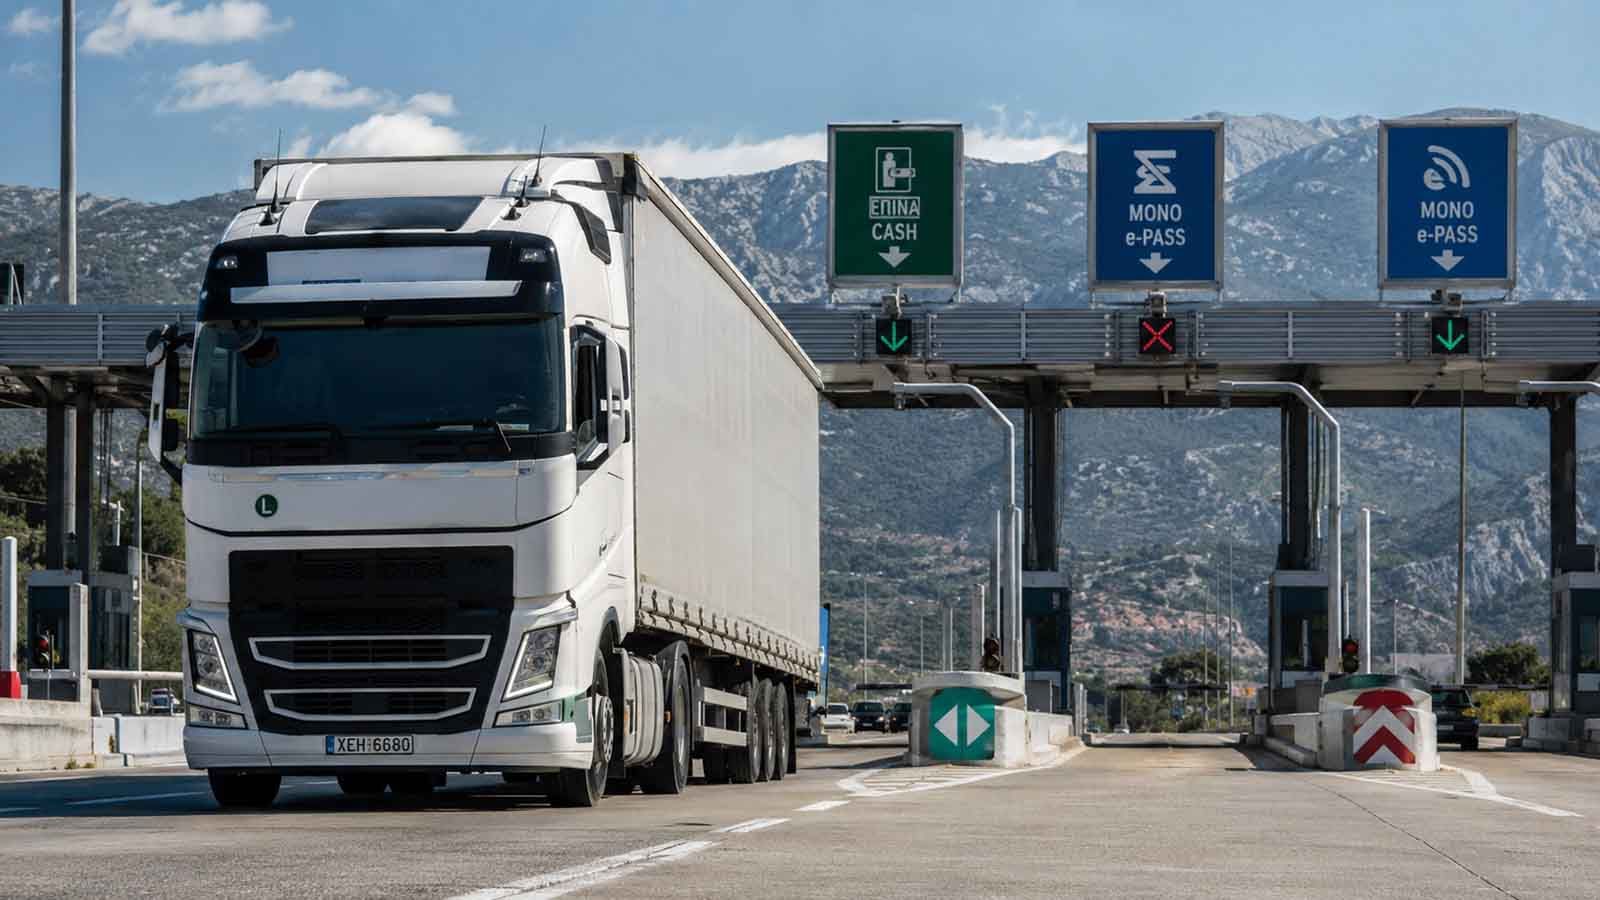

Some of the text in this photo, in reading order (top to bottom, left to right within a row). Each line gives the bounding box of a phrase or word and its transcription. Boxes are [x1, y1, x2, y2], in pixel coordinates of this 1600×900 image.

[872, 223, 917, 240] CASH
[1126, 228, 1186, 246] e-PASS
[1417, 225, 1478, 243] e-PASS
[262, 497, 272, 514] L
